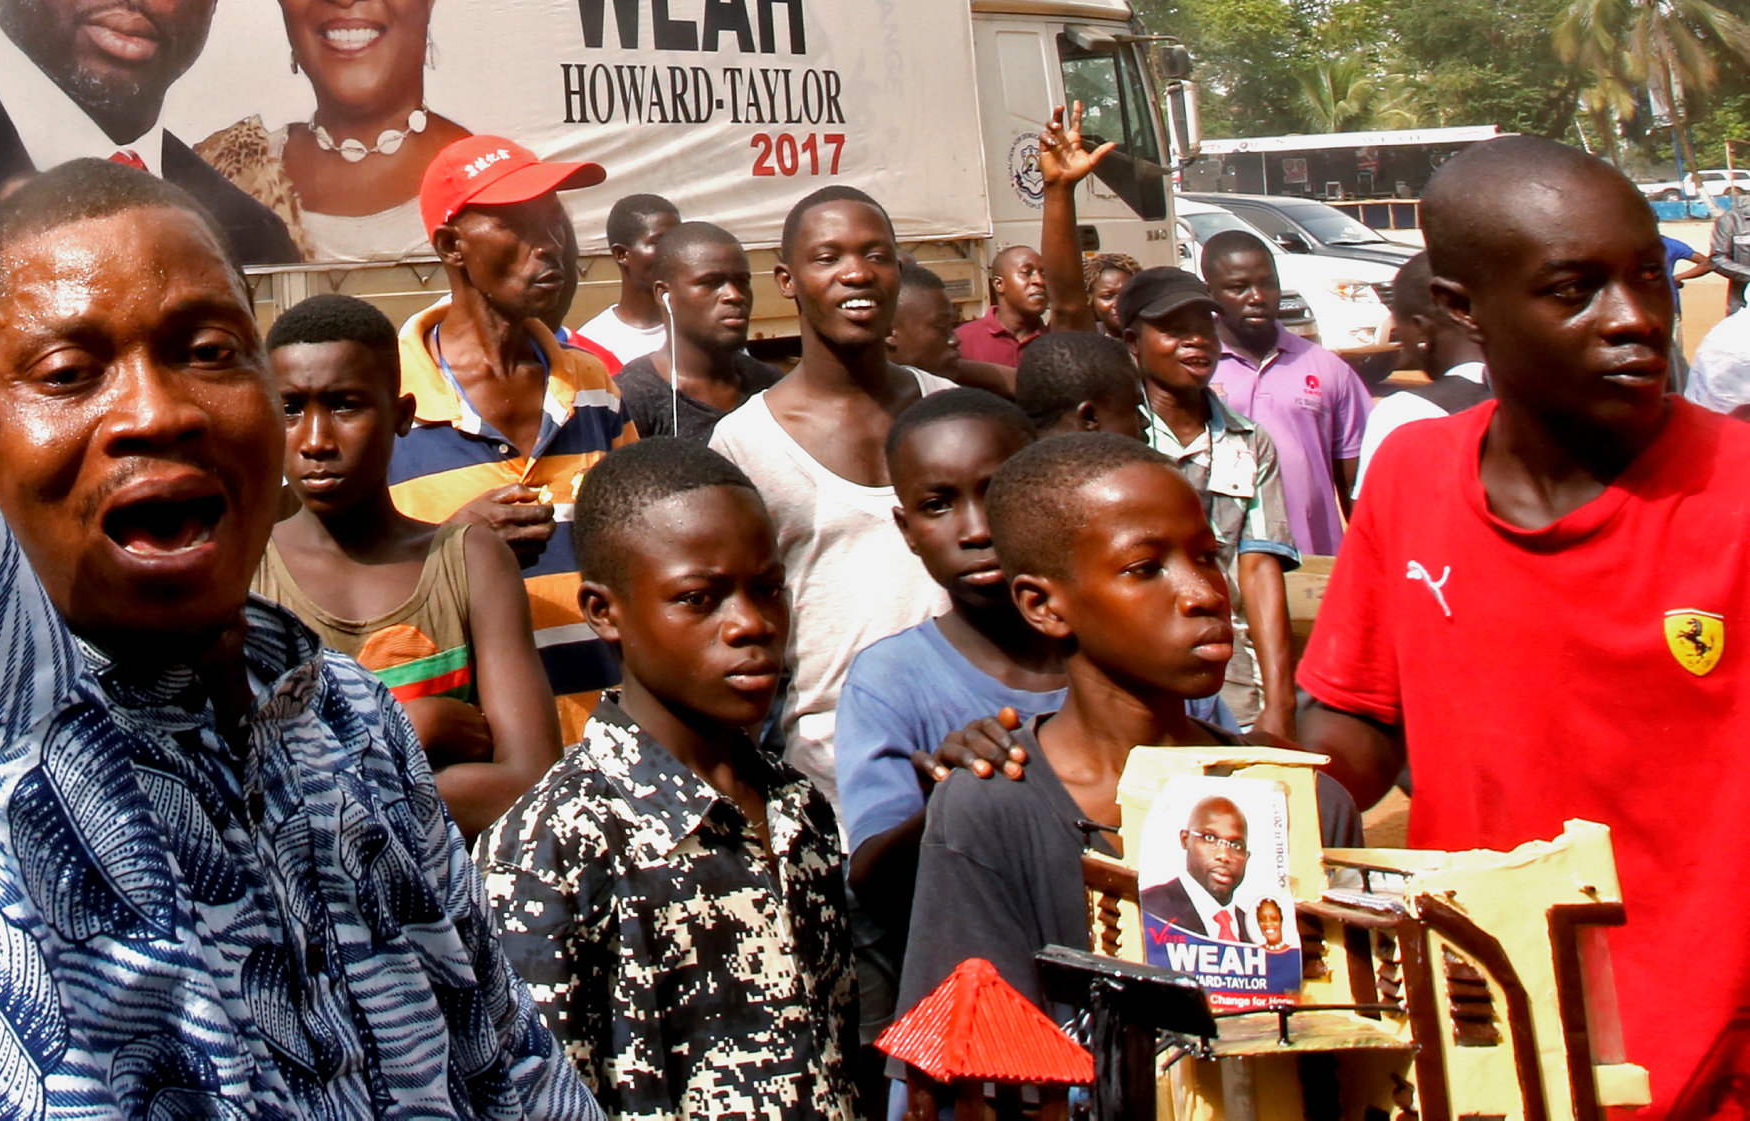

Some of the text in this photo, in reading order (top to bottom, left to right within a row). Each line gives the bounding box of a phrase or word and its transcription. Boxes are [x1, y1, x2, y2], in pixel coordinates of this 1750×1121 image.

[560, 62, 846, 124] HOWARD-TAYLOR
[751, 132, 846, 177] 2017
[1166, 942, 1267, 976] WEAH
[1196, 974, 1268, 991] ARD-TAYLOR
[1210, 993, 1250, 1008] Change
[1252, 995, 1266, 1007] for
